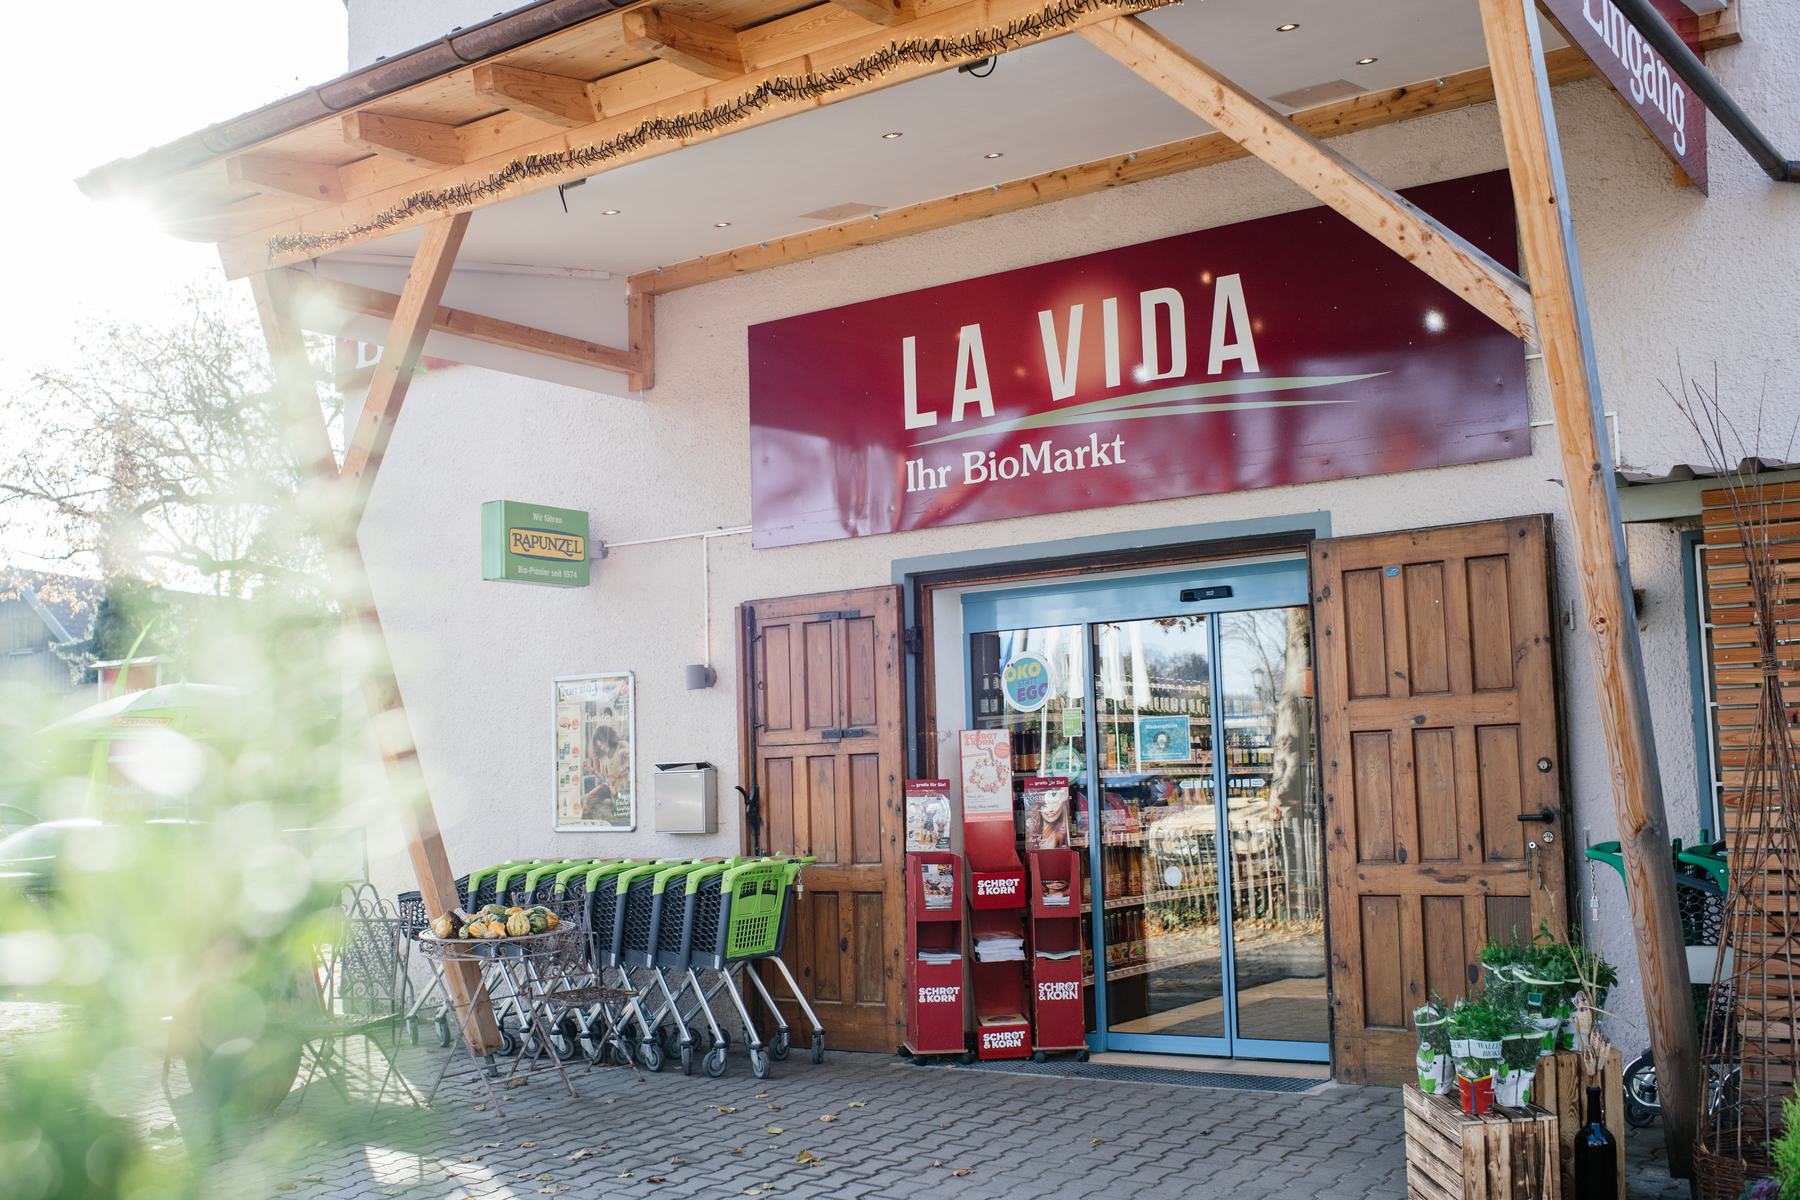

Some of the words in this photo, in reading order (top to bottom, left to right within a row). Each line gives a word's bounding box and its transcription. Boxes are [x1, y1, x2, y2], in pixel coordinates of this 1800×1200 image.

[901, 322, 996, 430] LA
[1037, 272, 1261, 402] VIDA
[905, 457, 953, 494] Ihr
[962, 431, 1127, 487] BioMarkt
[532, 512, 543, 522] Wir
[544, 513, 563, 524] führen
[511, 532, 583, 557] RAPUNZEL
[517, 565, 550, 577] Bio-Pionier
[551, 570, 562, 578] seit
[563, 570, 578, 579] 1974
[1004, 662, 1041, 683] ÖKO
[1017, 682, 1049, 702] EGO
[977, 878, 1020, 888] SCHROT
[918, 986, 961, 995] SCHROT
[1038, 981, 1080, 992] SCHROT
[983, 1031, 1026, 1041] SCHROT
